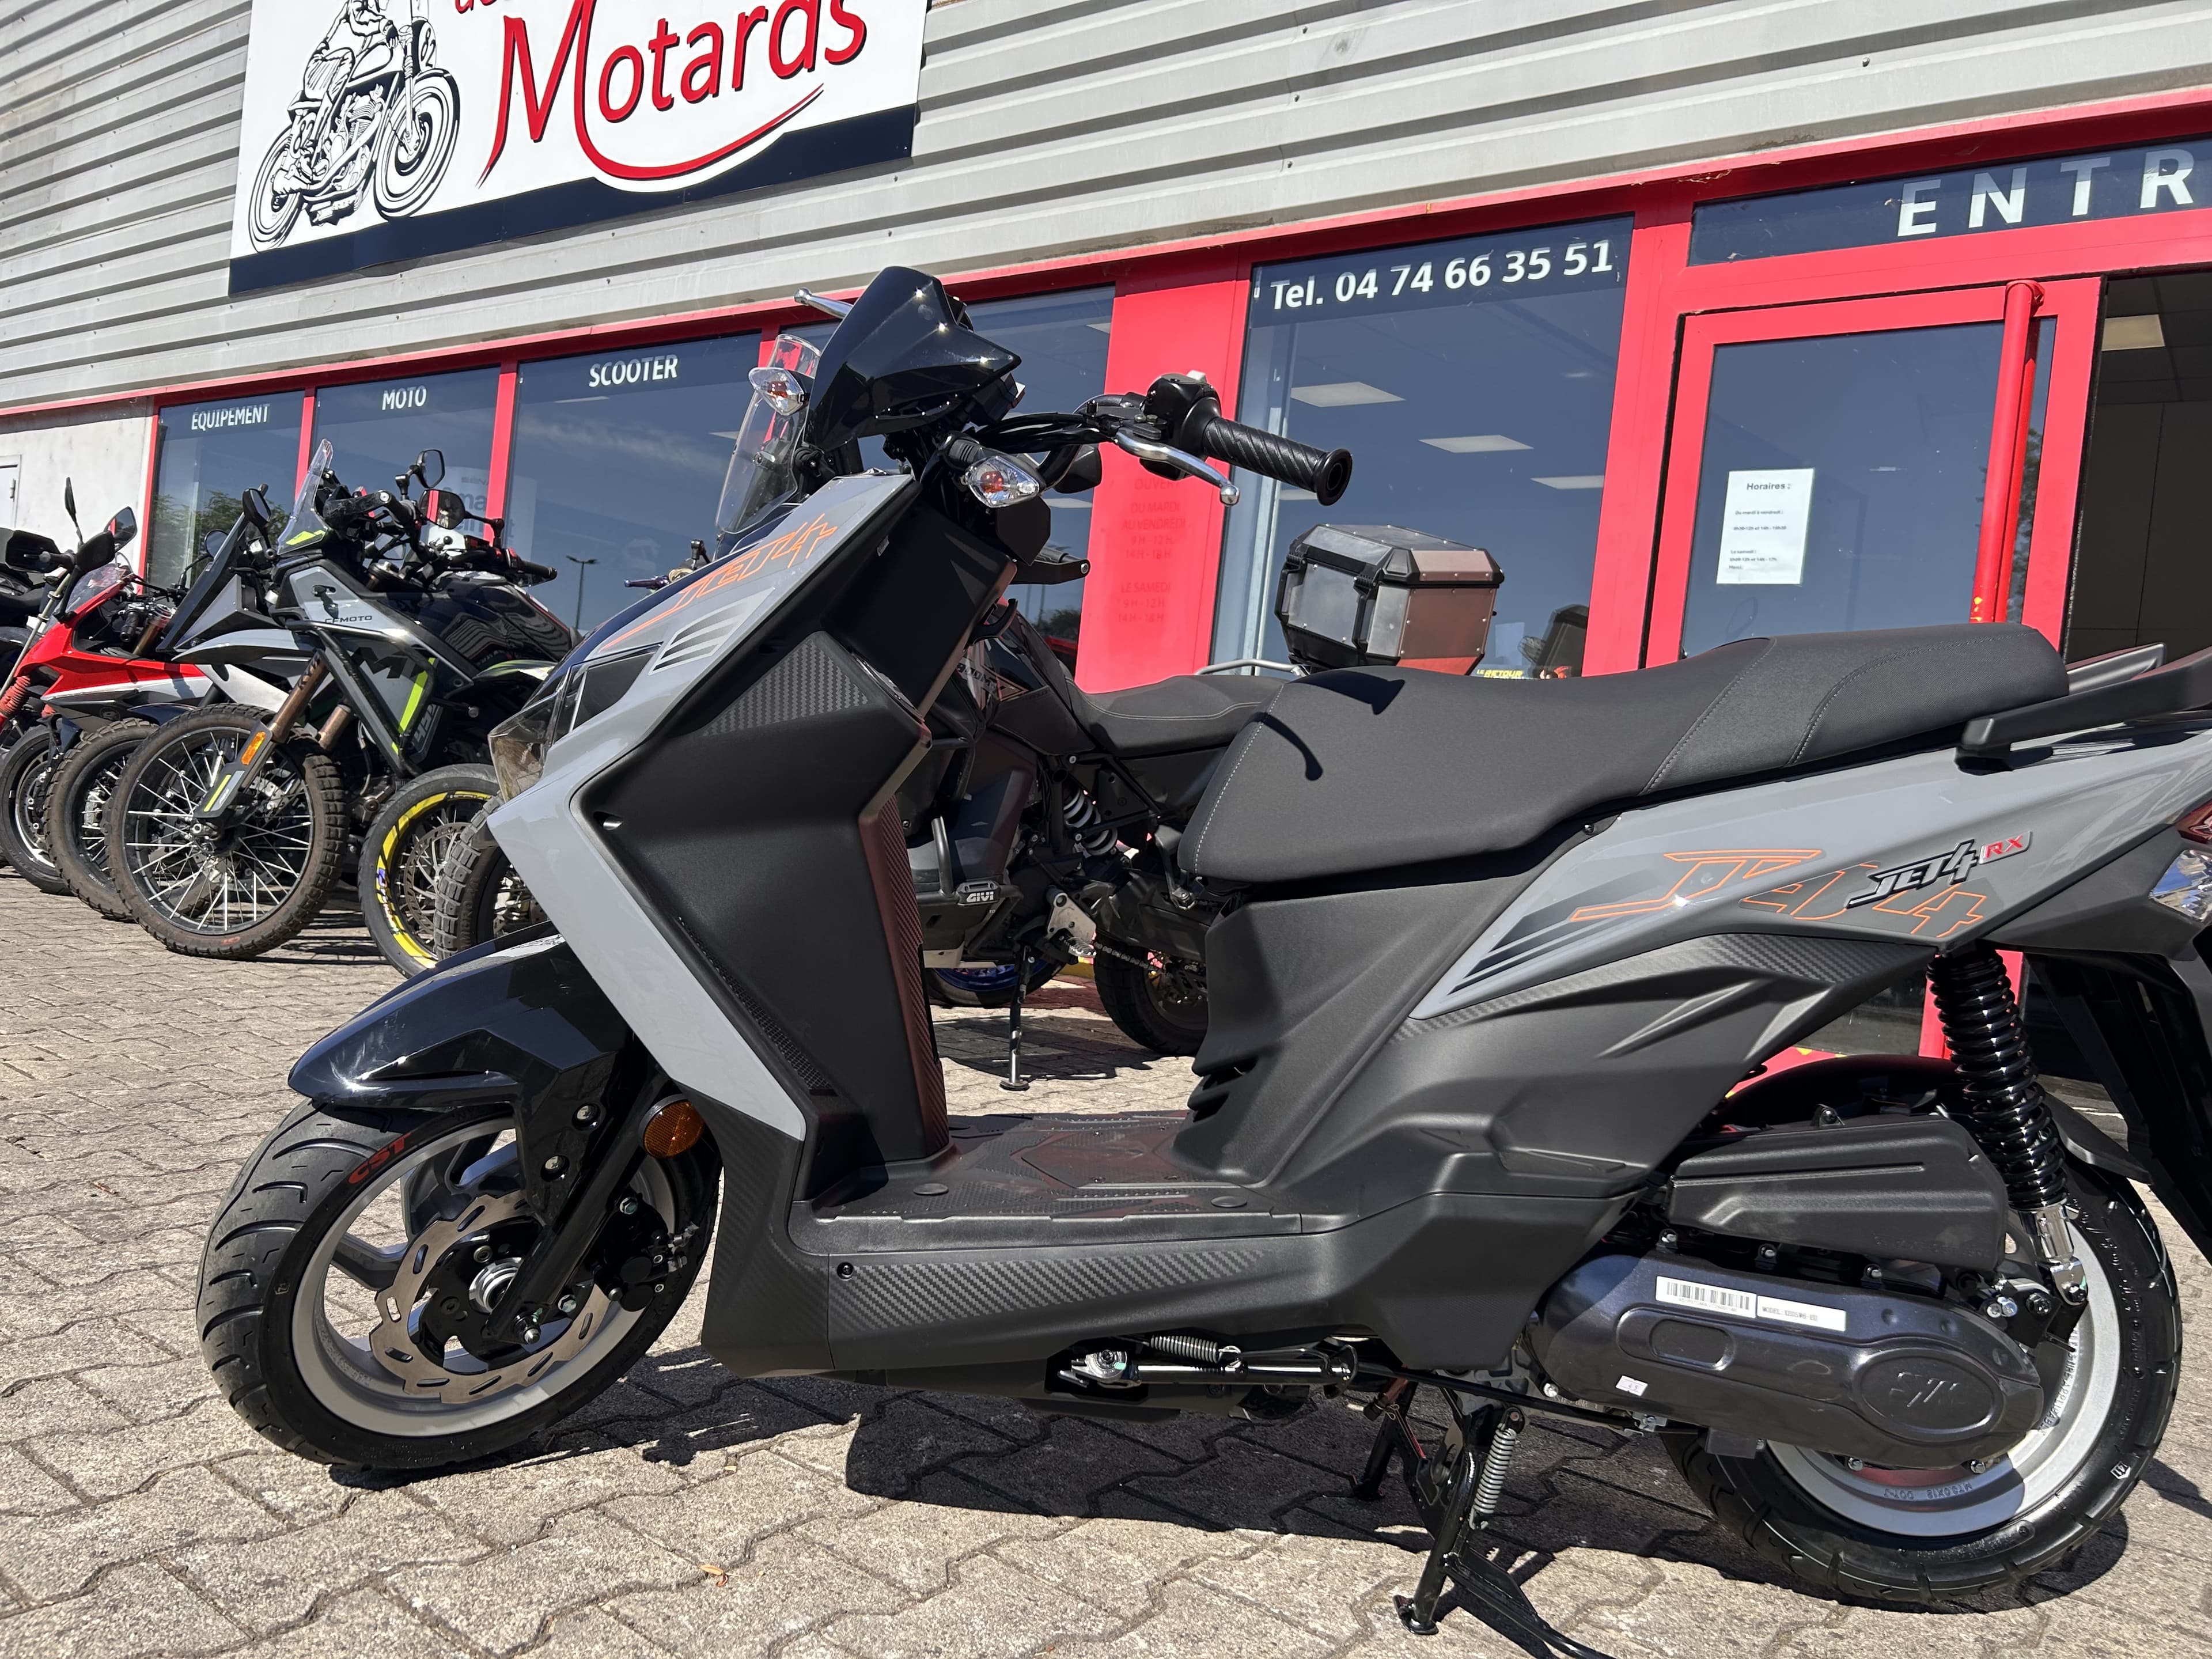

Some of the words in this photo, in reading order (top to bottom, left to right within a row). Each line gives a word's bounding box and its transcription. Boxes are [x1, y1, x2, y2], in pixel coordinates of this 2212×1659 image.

[476, 0, 869, 185] Motards
[1897, 148, 2195, 237] ENTR
[1270, 275, 1324, 309] Tel.
[1335, 268, 1378, 302] 04
[1390, 262, 1434, 296] 74
[1444, 256, 1492, 289] 66
[1502, 247, 1551, 283] 35
[1563, 240, 1613, 276] 51
[589, 354, 679, 388] SCOOTER
[381, 385, 427, 411] MOTO
[191, 403, 270, 431] ÉQUIPEMENT
[1747, 482, 1785, 490] Horaires
[324, 615, 373, 623] CFMOTO
[1846, 839, 1979, 908] JET4
[1984, 834, 2024, 859] RX
[966, 891, 994, 903] GIVI
[348, 1132, 412, 1184] CST
